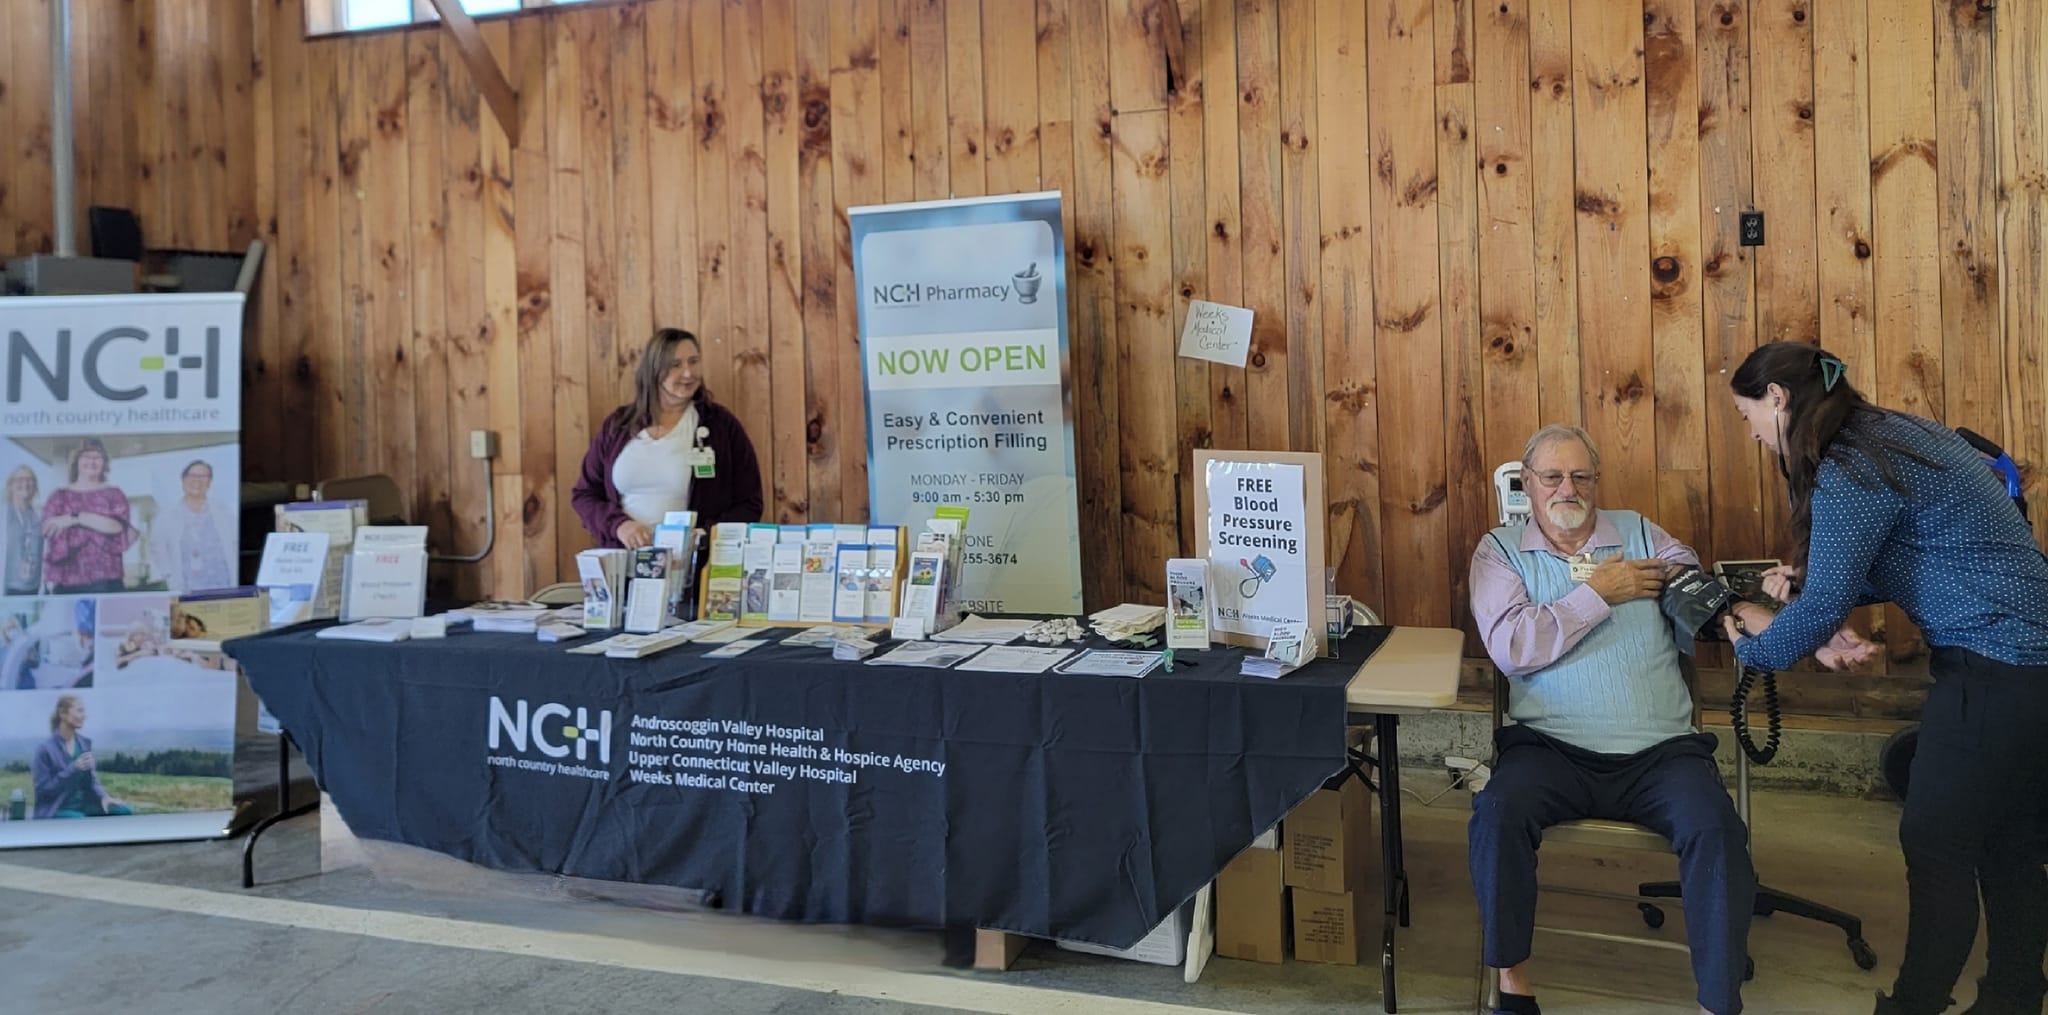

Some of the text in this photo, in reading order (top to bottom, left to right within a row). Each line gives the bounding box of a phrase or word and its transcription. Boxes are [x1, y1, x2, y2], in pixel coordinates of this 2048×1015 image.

[873, 283, 1010, 304] NCH Pharmacy
[1191, 321, 1227, 336] Medical
[1199, 335, 1238, 350] Center
[6, 326, 220, 403] NCH
[877, 344, 1047, 376] NOW OPEN
[3, 407, 221, 426] north country healthcare
[883, 410, 1044, 431] Easy & Convenient
[887, 433, 1048, 452] Prescription Filling
[911, 474, 967, 486] MONDAY
[979, 473, 1025, 486] FRIDAY
[1236, 477, 1273, 493] FREE
[912, 491, 939, 503] 9:00
[942, 494, 962, 503] am
[974, 491, 1000, 503] 5:30
[1004, 494, 1025, 505] pm
[1233, 496, 1279, 513] Blood
[1223, 513, 1293, 532] Pressure
[965, 535, 994, 548] ONE
[1218, 531, 1297, 554] Screening
[960, 600, 1005, 613] BSITE
[1217, 607, 1240, 619] NCH
[488, 695, 613, 765] NCH
[630, 714, 824, 743] Androscoggin Valley Hospital
[630, 732, 946, 777] North Country Home Health & Hospice Agency
[487, 754, 610, 781] north country healthcare
[628, 751, 857, 784] Upper Connecticut Valley Hospital
[629, 769, 776, 795] Weeks Medical Center
